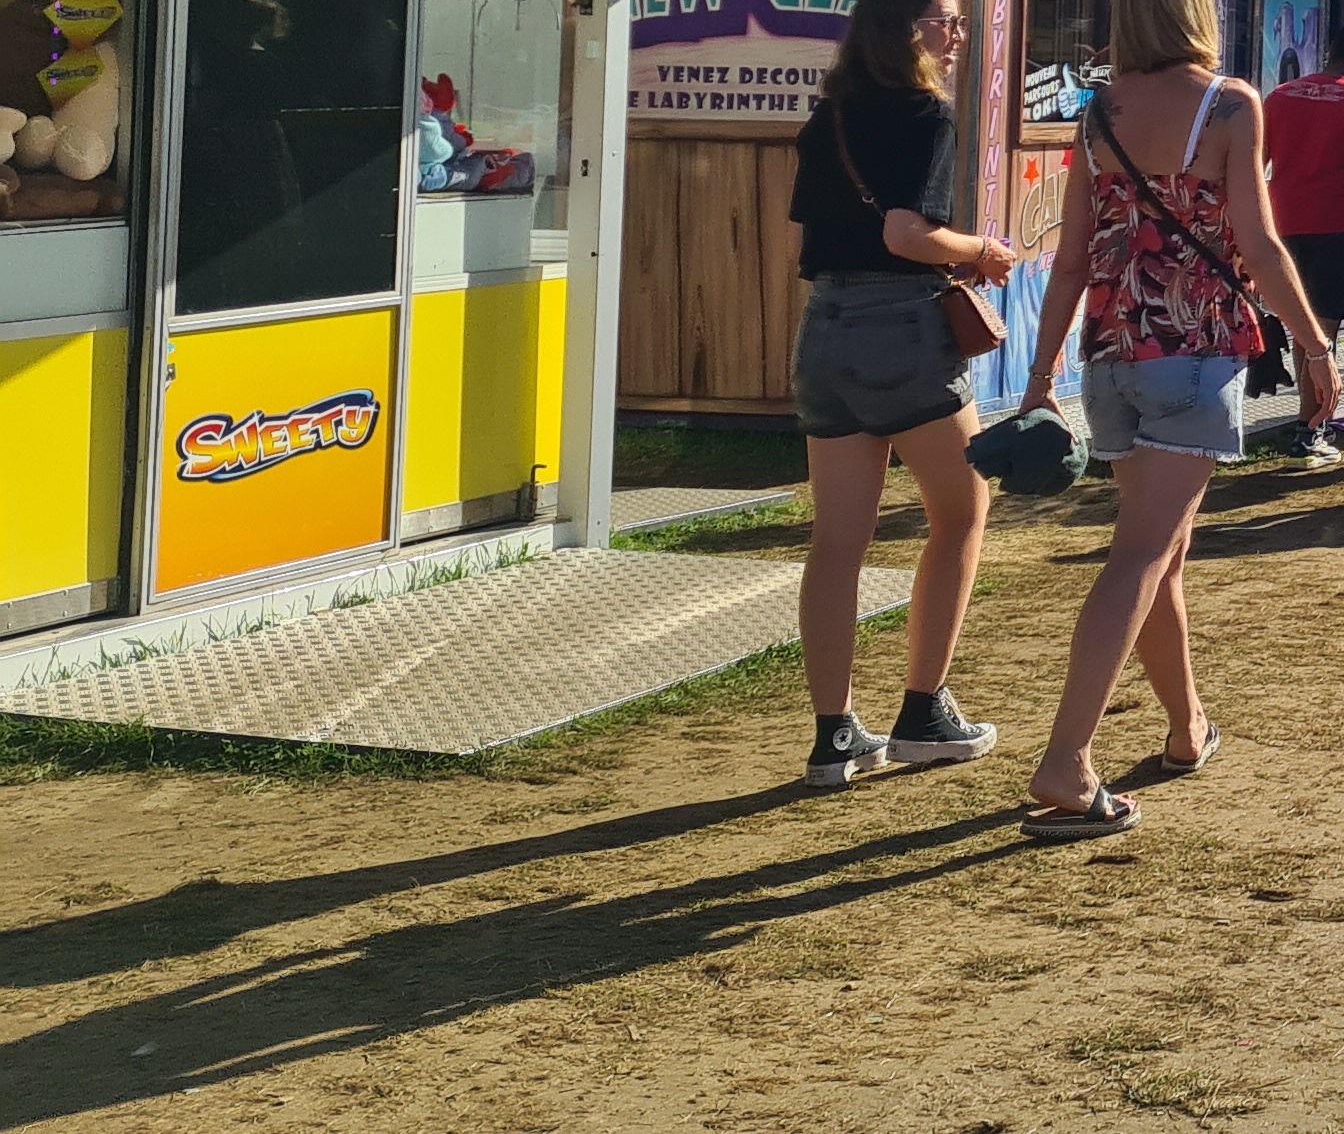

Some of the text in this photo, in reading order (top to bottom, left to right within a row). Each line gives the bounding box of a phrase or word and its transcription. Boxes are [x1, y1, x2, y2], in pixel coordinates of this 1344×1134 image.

[657, 65, 730, 84] VENEZ
[648, 91, 798, 112] LABYRINTHE
[1024, 79, 1061, 106] PARCOURS
[182, 402, 376, 478] SWEETY
